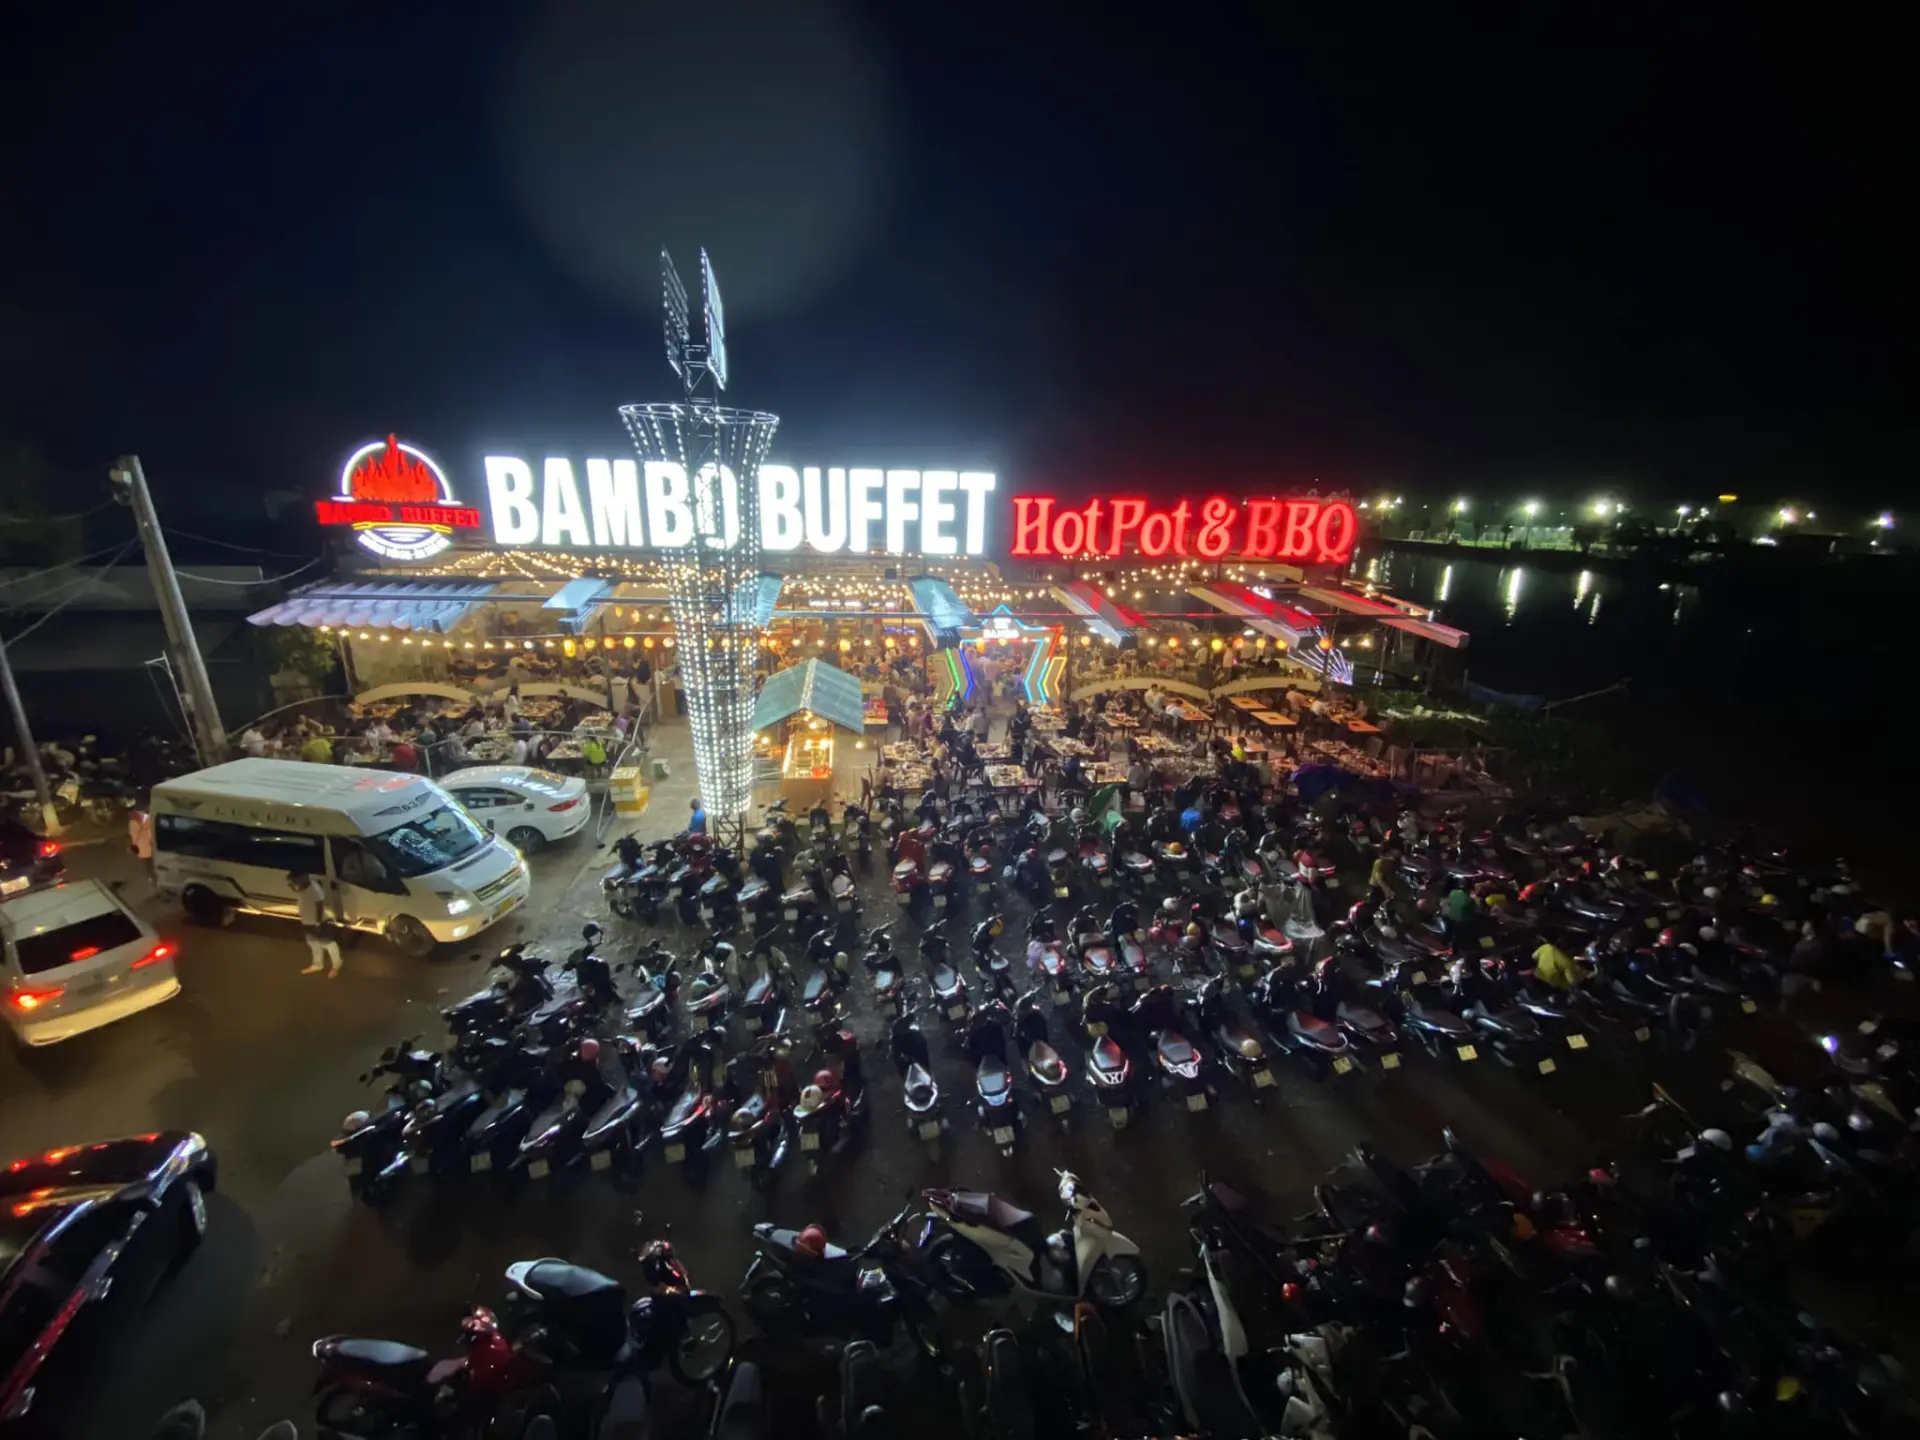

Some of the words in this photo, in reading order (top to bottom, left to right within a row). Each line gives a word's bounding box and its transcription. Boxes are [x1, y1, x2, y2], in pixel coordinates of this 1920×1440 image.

[484, 456, 740, 551] BAMBO
[758, 464, 996, 555] BUFFET
[1011, 497, 1104, 557] Hot
[1105, 498, 1192, 557] Pot
[1196, 497, 1237, 557] &
[1241, 499, 1358, 564] BBQ
